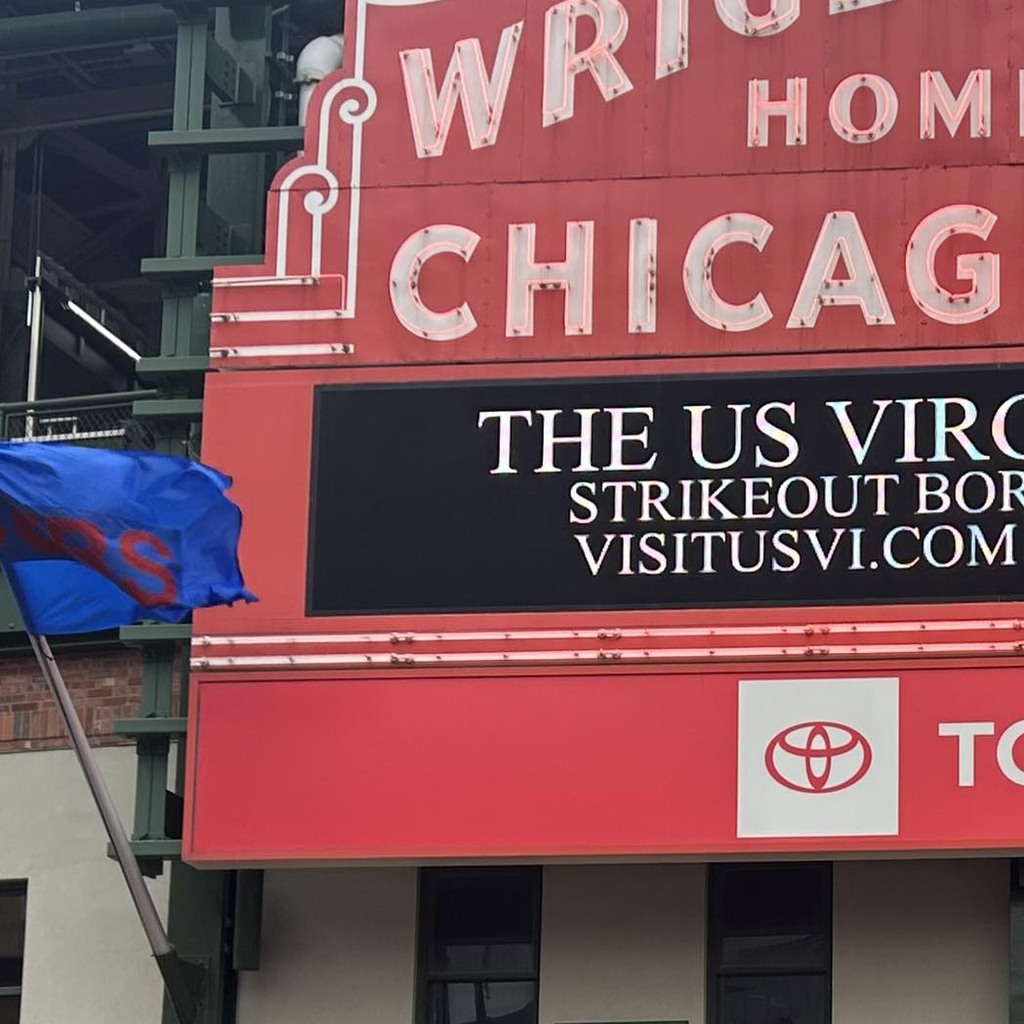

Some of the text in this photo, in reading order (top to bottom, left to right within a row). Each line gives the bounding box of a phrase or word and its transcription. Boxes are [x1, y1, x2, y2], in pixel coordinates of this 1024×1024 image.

[399, 0, 900, 158] WRI
[478, 406, 658, 474] THE
[683, 401, 799, 470] US
[568, 474, 900, 524] STRIKEOUT
[574, 523, 1018, 576] VISITUSVI.COM
